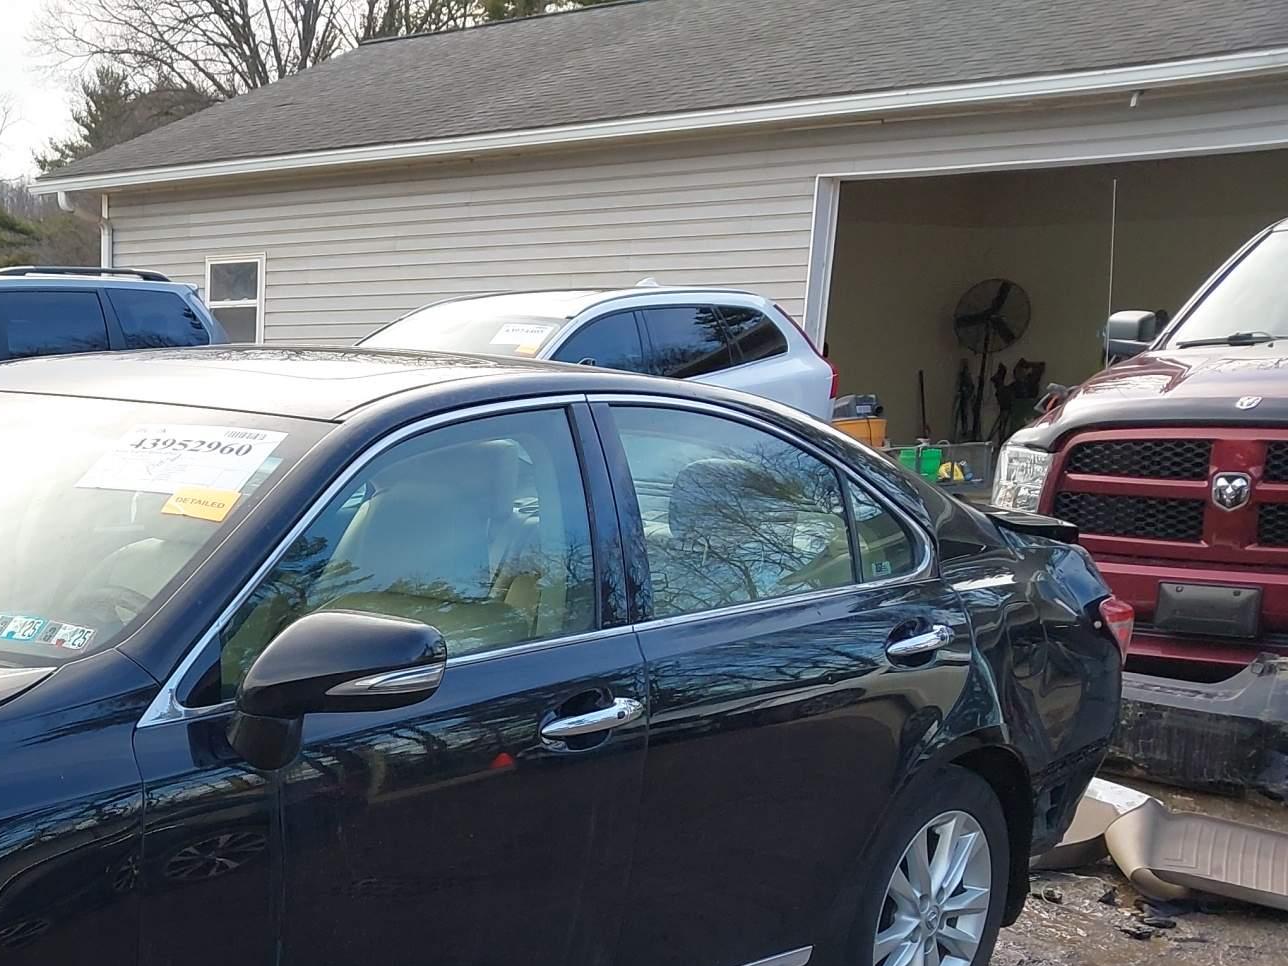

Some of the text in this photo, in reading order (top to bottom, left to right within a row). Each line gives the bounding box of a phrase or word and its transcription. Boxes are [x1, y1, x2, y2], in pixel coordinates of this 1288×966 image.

[129, 438, 253, 456] 43952960
[175, 496, 226, 509] DETAILED
[22, 620, 42, 638] 25
[72, 629, 92, 648] 25
